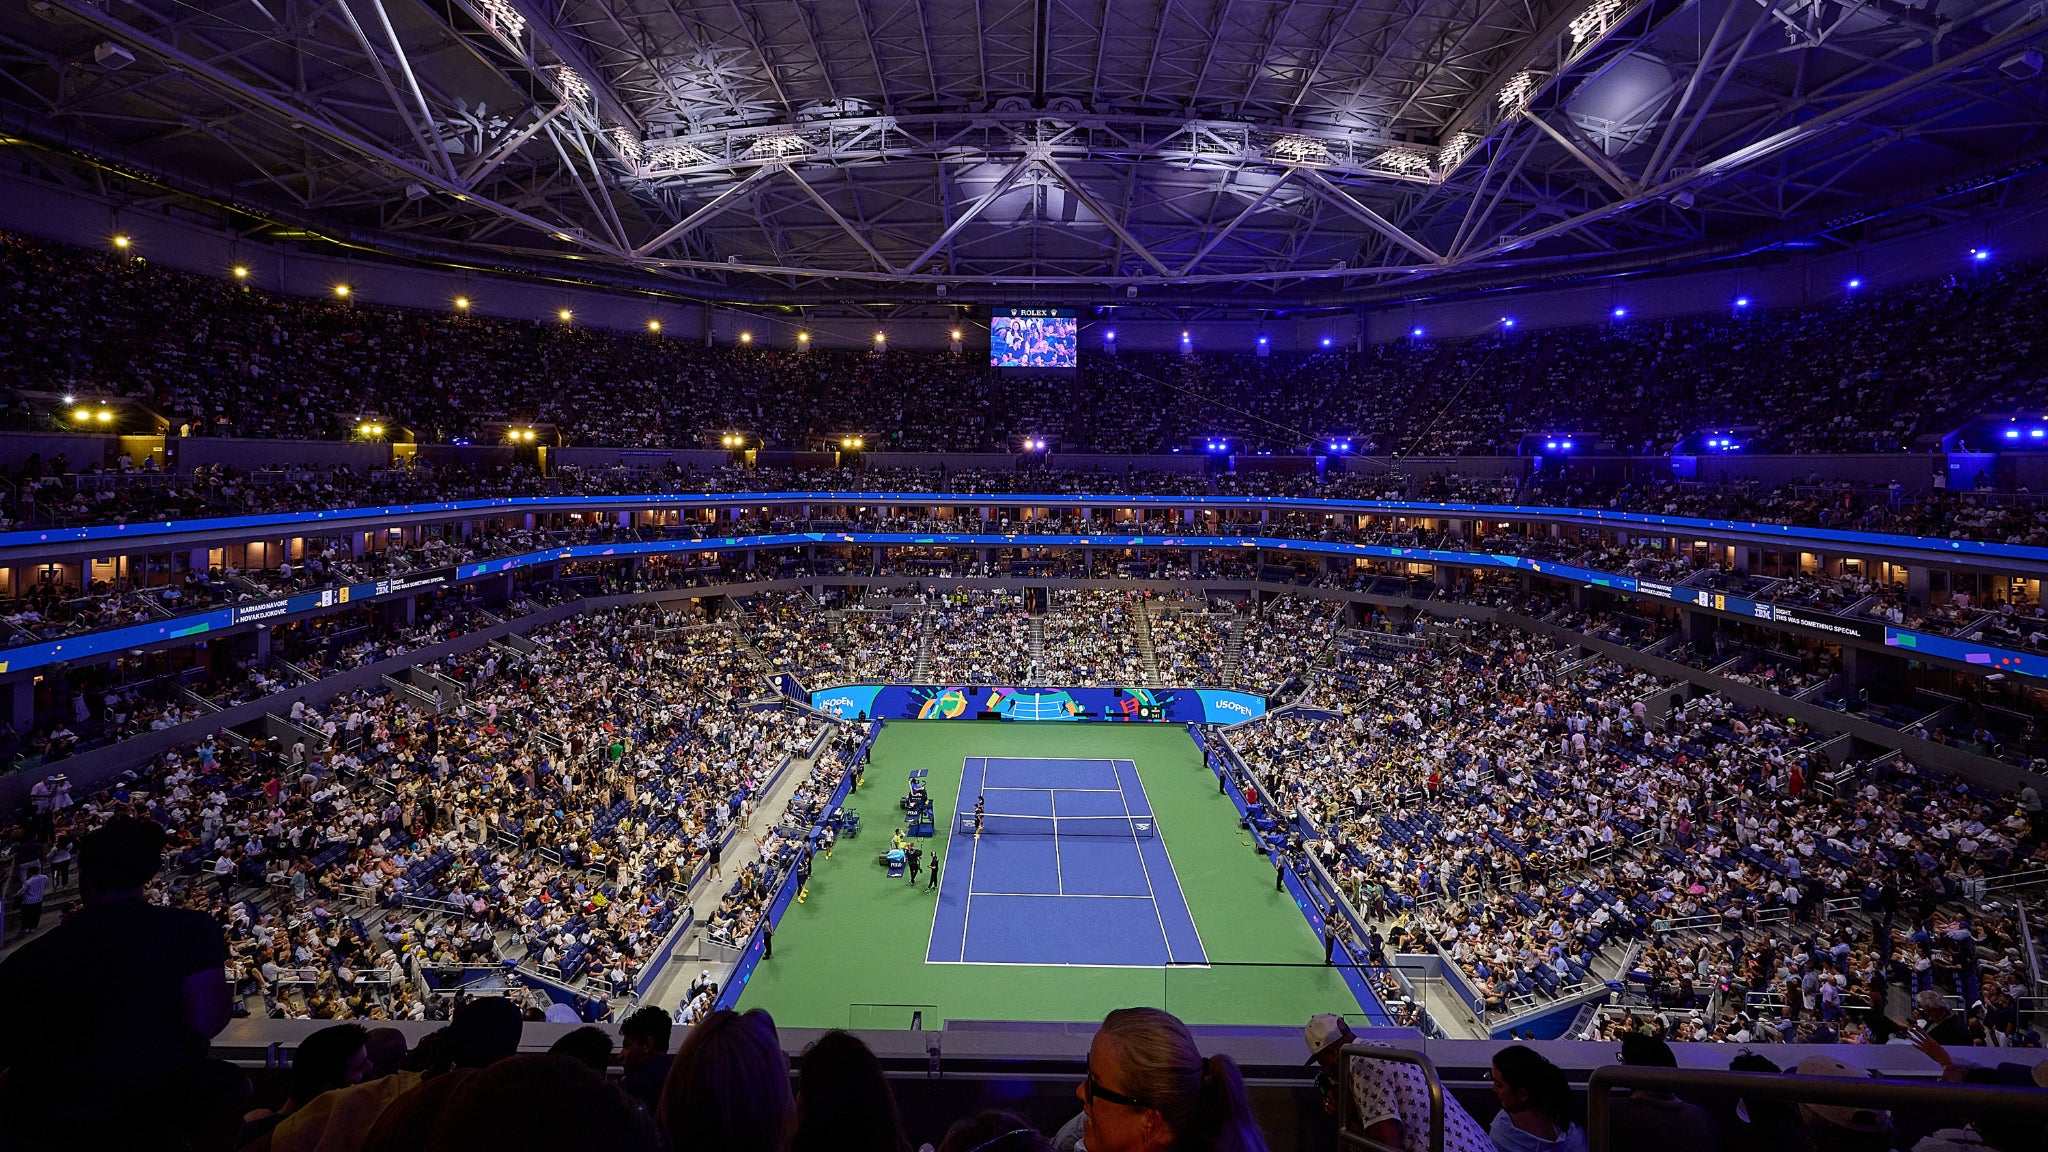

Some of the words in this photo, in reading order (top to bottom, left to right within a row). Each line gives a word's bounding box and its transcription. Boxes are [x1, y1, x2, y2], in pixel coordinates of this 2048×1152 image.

[376, 586, 389, 595] IBM
[240, 603, 265, 614] MARIANO
[266, 600, 288, 609] NAVONE
[1754, 608, 1772, 620] IBM
[240, 613, 260, 623] NOVAK
[260, 608, 287, 618] DJOKOVIC
[1800, 619, 1833, 631] SOMETHING
[1834, 626, 1861, 636] SPECIAL.
